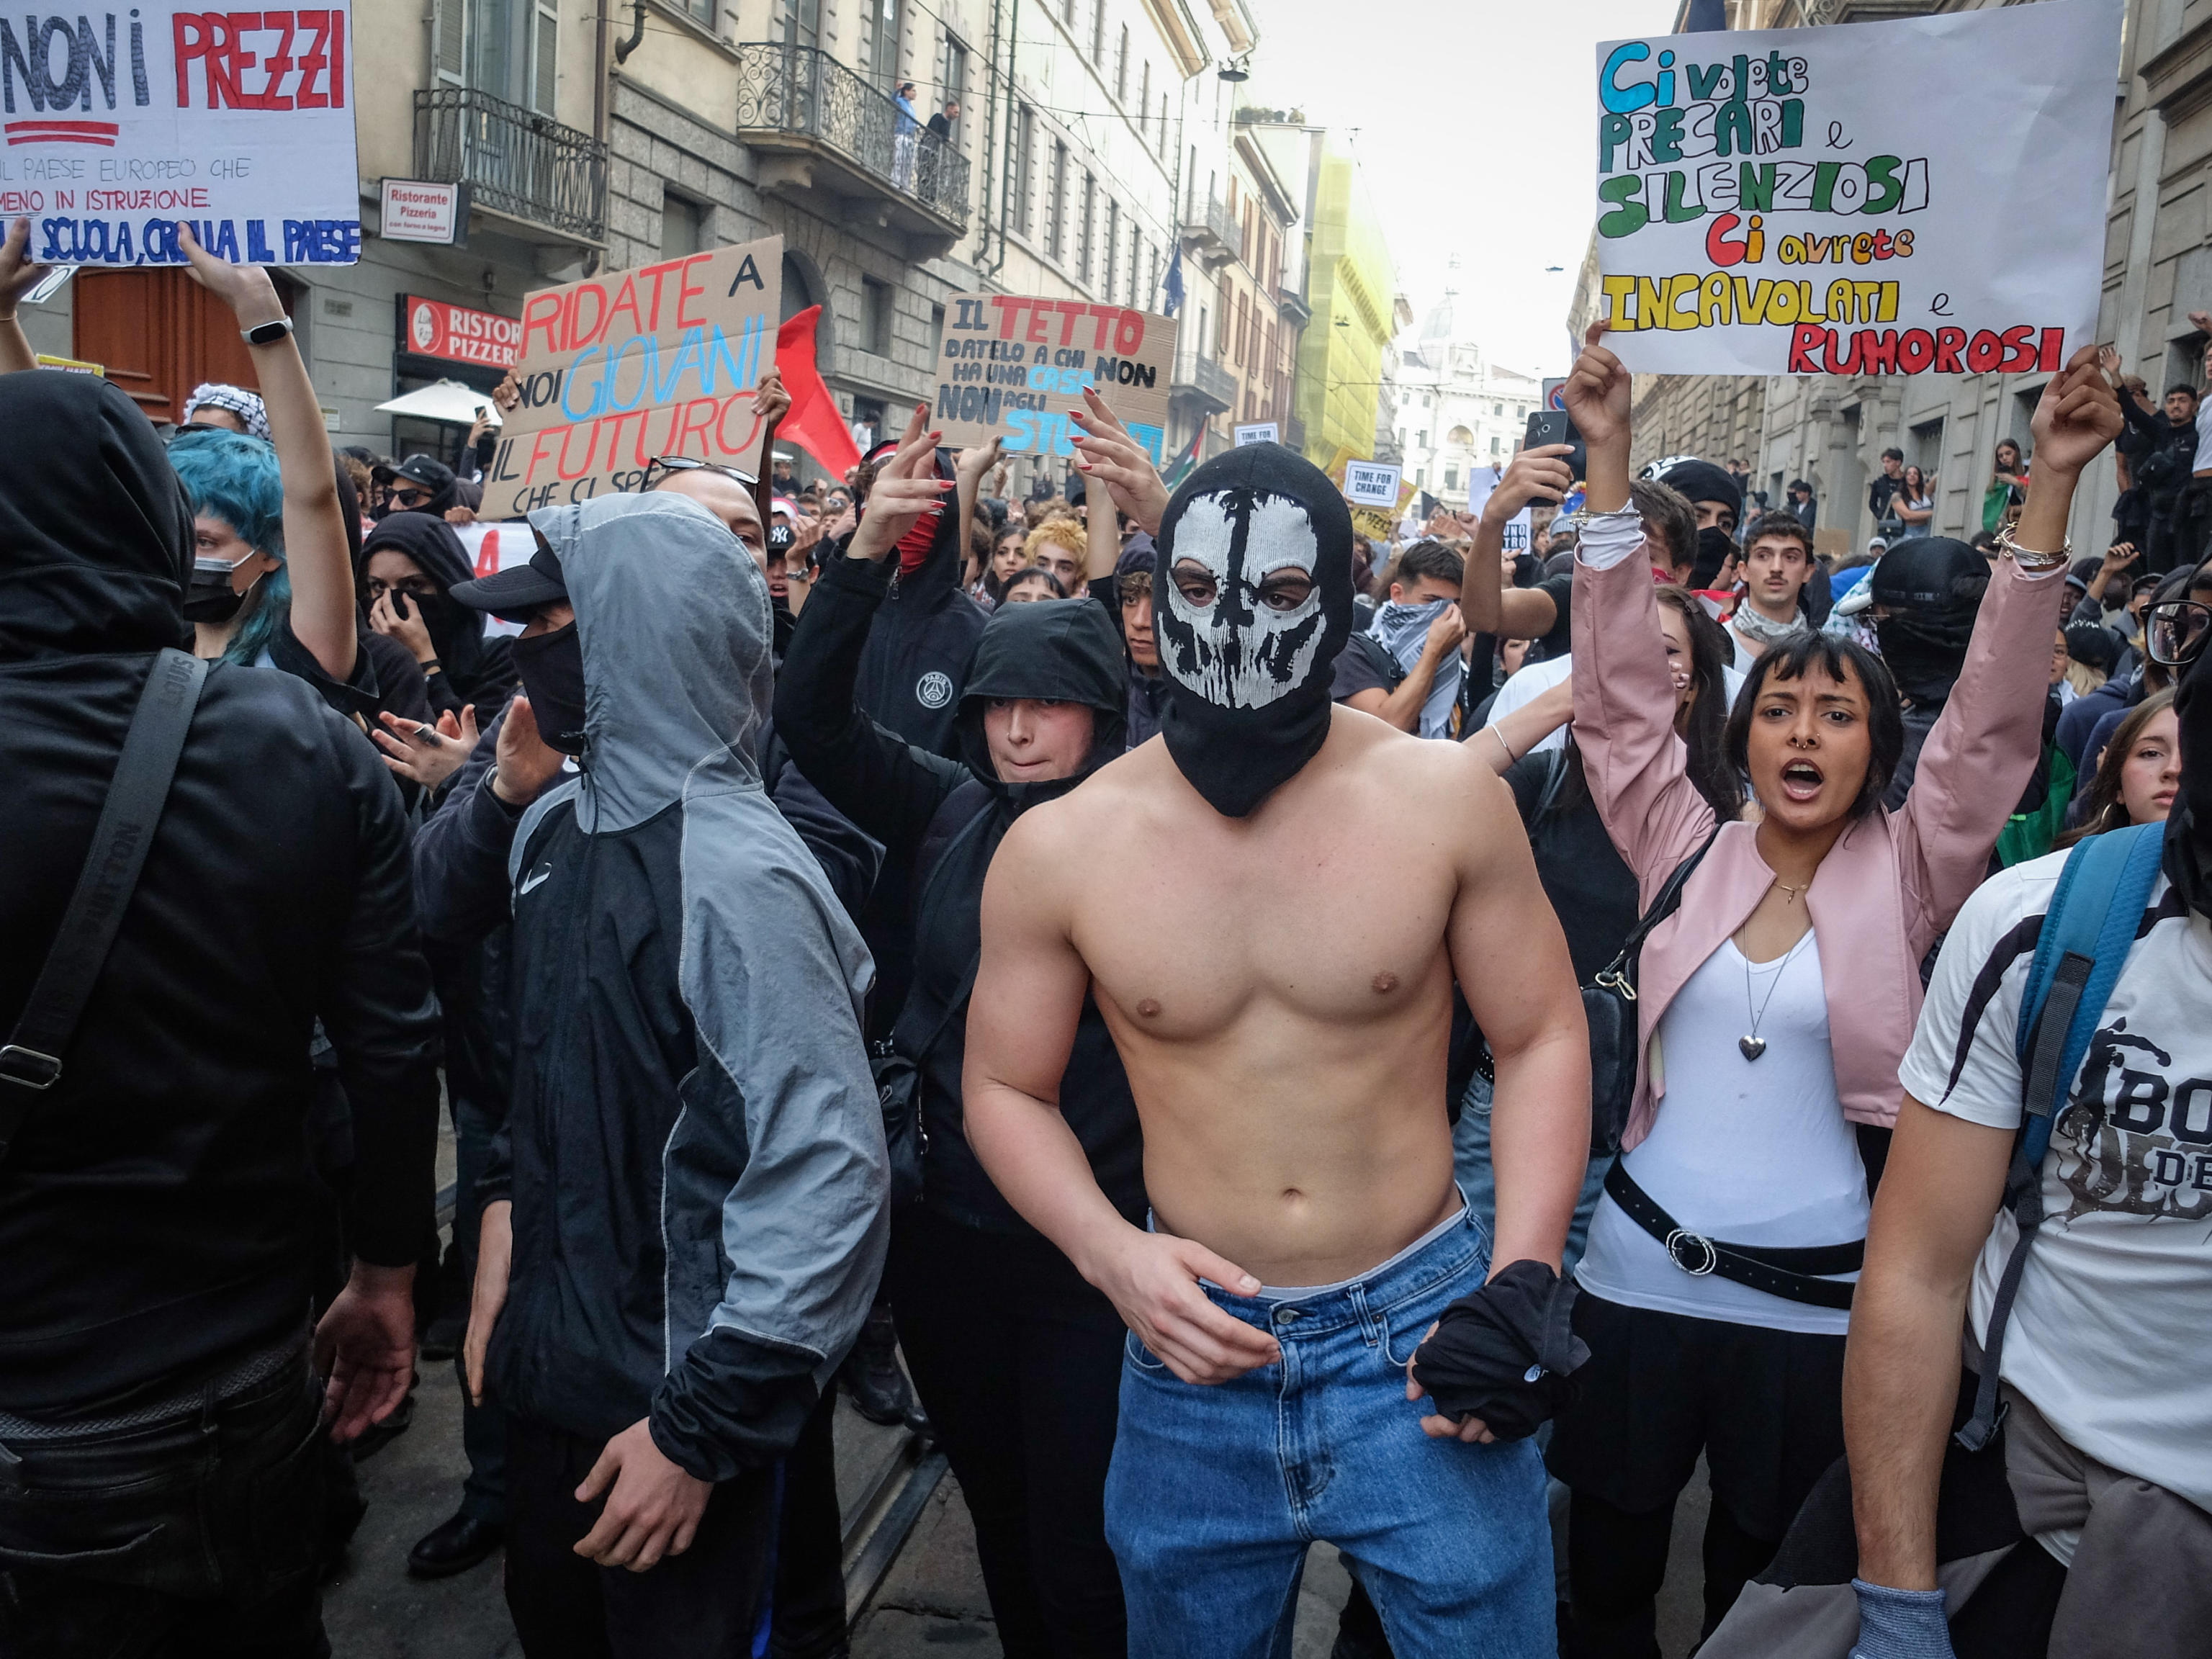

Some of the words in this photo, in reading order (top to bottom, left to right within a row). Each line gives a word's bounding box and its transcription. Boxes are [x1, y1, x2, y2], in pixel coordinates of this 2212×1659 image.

[0, 13, 116, 113] NON
[130, 9, 150, 106] i
[173, 10, 344, 110] PREZZI
[1599, 41, 1675, 114] Ci
[1685, 50, 1808, 102] volete
[1600, 99, 1804, 174] PRECARI
[1825, 121, 1853, 149] e
[24, 158, 85, 181] PAESE
[100, 158, 196, 181] EUROPEO
[210, 158, 251, 179] CHE
[55, 189, 74, 210] IN
[86, 188, 211, 211] ISTRUZIONE.
[391, 189, 448, 205] Ristorante
[400, 206, 437, 219] Pizzeria
[1598, 155, 1929, 238] SILENZIOSI
[247, 219, 275, 262] IL
[283, 219, 360, 262] PAESE
[1706, 214, 1764, 266] Ci
[1778, 228, 1915, 265] avrete
[449, 308, 521, 345] RISTOR
[521, 255, 712, 359] RIDATE
[728, 253, 765, 297] A
[953, 299, 989, 331] IL
[991, 295, 1145, 356] TETTO
[1602, 271, 1899, 332] INCAVOLATI
[1928, 293, 1954, 315] e
[561, 314, 765, 422] GIOVANI
[945, 338, 1025, 362] DATELO
[1034, 345, 1048, 364] A
[1054, 348, 1085, 369] CHI
[1094, 356, 1156, 388] NON
[953, 362, 981, 382] HA
[986, 363, 1026, 387] UNA
[1788, 324, 2065, 375] RUMOROSI
[938, 384, 1002, 425] NON
[1003, 391, 1046, 411] AGLI
[491, 439, 520, 483] IL
[525, 392, 763, 485] FUTURO
[571, 477, 597, 505] CI
[1354, 470, 1374, 482] TIME
[1376, 472, 1392, 484] FOR
[1355, 484, 1387, 496] CHANGE
